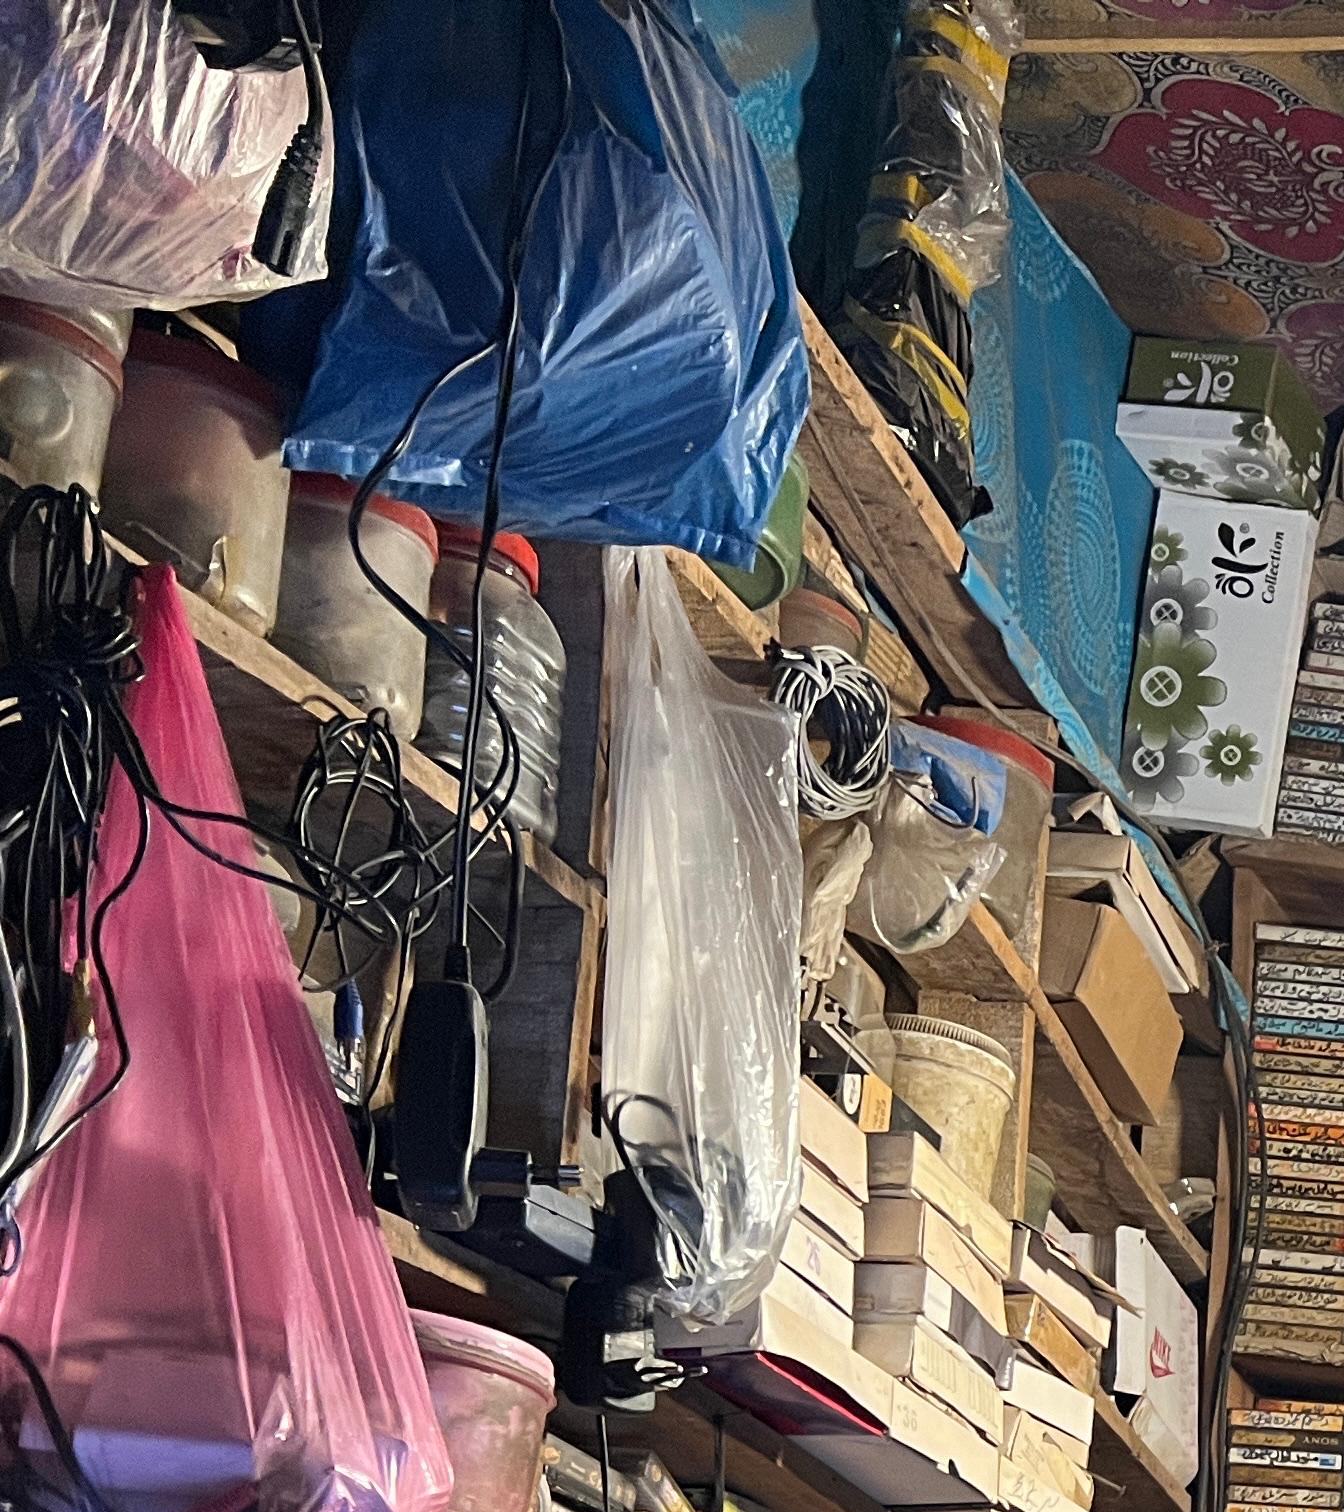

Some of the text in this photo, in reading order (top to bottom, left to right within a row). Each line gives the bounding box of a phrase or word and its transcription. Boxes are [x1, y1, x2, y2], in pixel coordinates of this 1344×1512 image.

[1171, 351, 1239, 365] Collection
[1262, 531, 1285, 604] Collection
[1302, 1435, 1339, 1446] SONY
